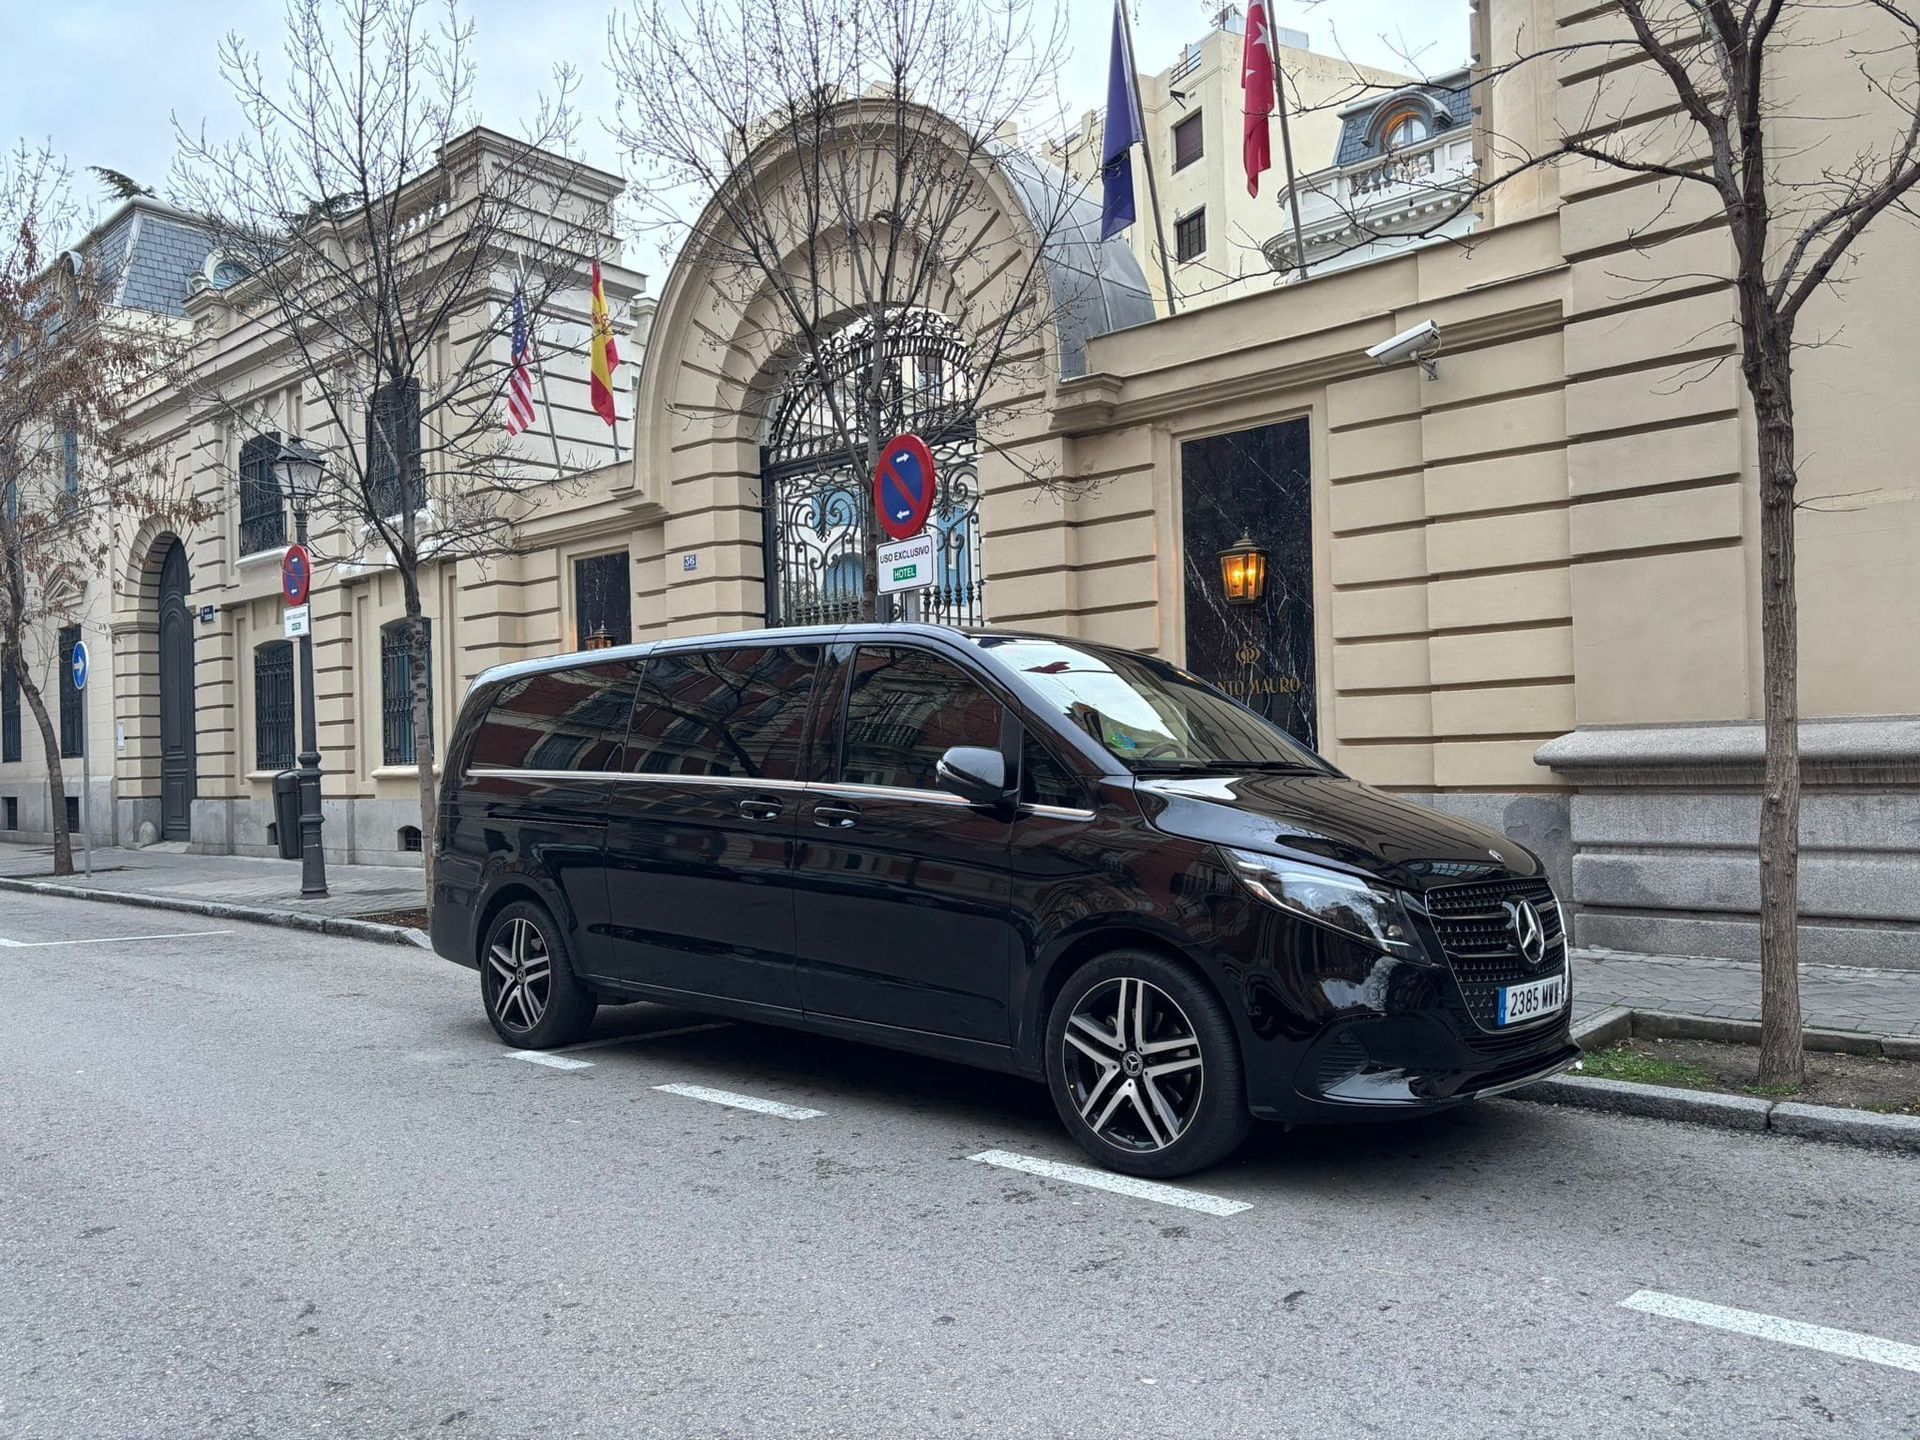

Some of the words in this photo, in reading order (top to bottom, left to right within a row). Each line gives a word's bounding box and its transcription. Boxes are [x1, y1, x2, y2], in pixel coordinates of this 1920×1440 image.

[879, 552, 893, 564] USO
[894, 545, 930, 562] EXCLUSIVO
[894, 566, 916, 579] HOTEL
[1211, 680, 1244, 696] NTO
[1250, 676, 1301, 695] MAURO
[1510, 987, 1539, 1017] 2385
